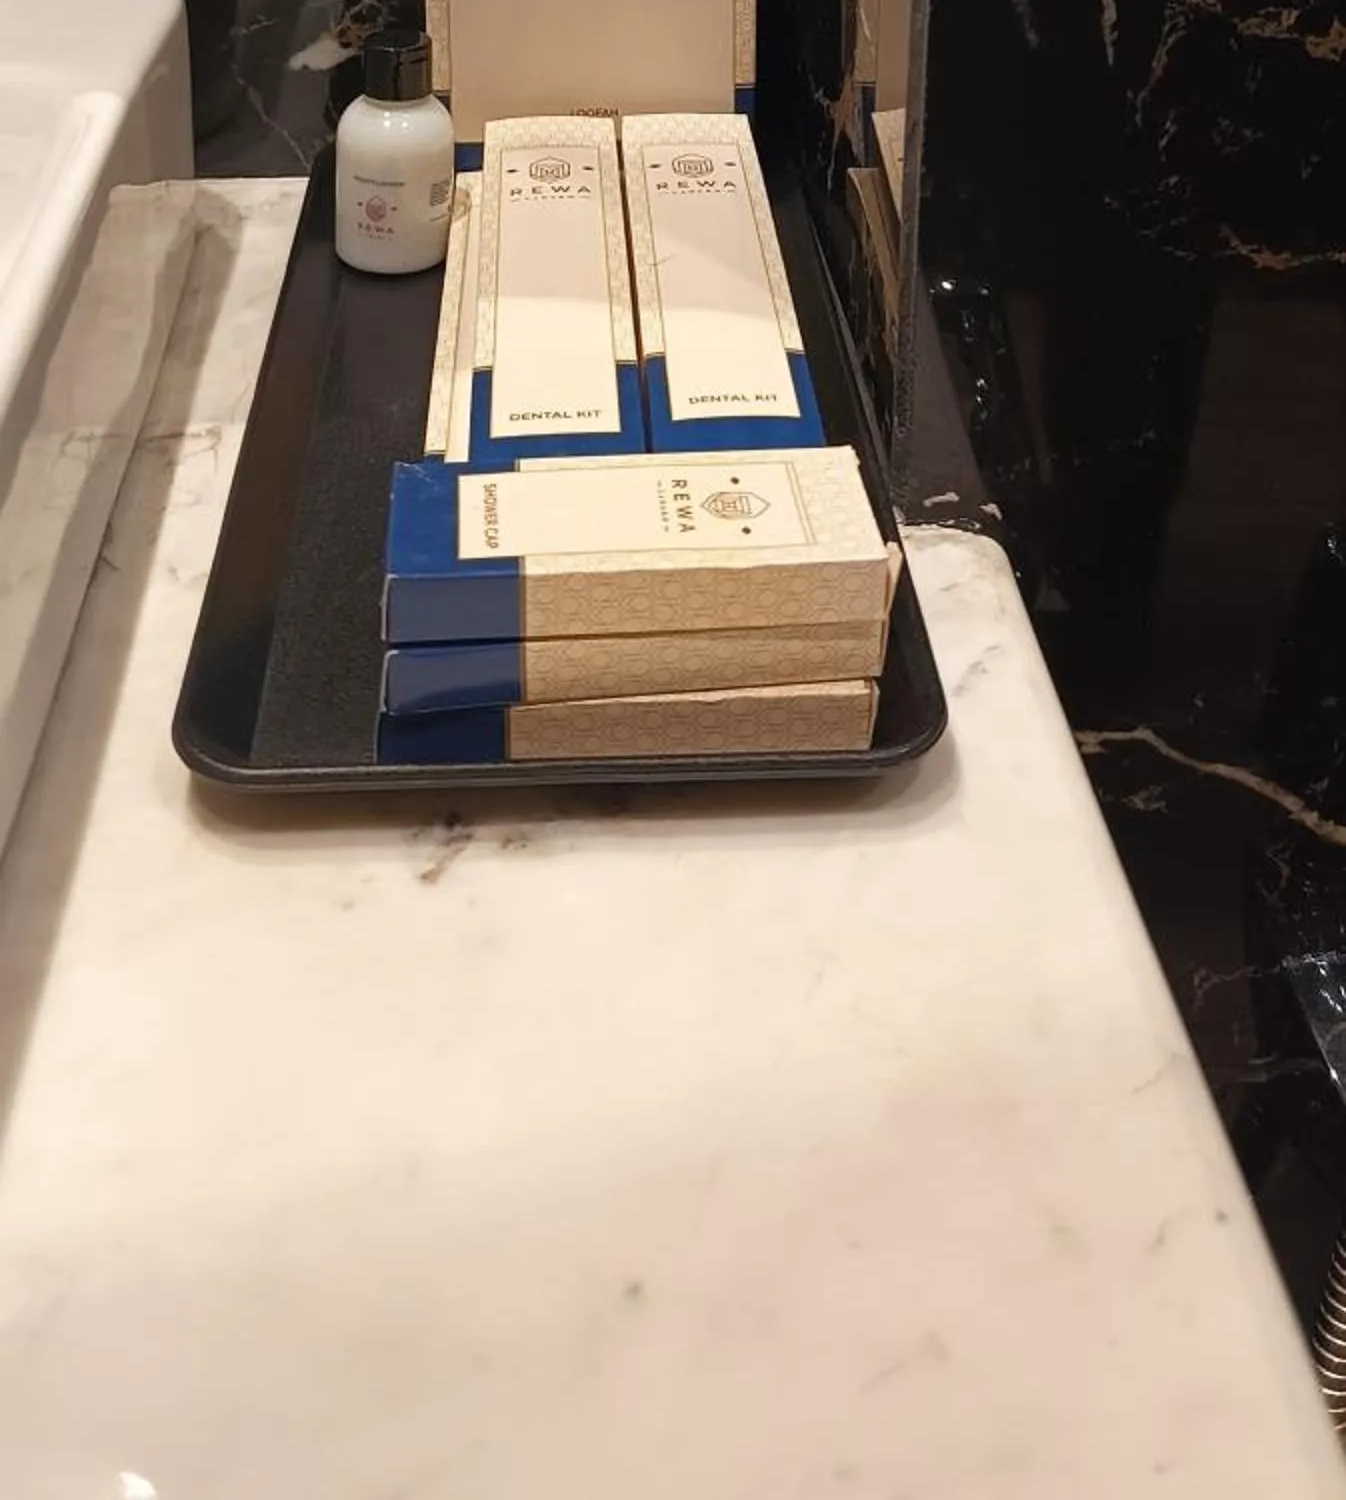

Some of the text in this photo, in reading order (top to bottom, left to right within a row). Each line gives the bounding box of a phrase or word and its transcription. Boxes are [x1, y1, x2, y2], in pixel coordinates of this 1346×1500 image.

[509, 185, 591, 196] REWA
[656, 180, 737, 190] REWA
[687, 393, 778, 405] DENTAL KIT
[508, 408, 602, 421] DENTAL KIT
[671, 479, 697, 533] REWA
[483, 483, 500, 549] SHOWER CAP
